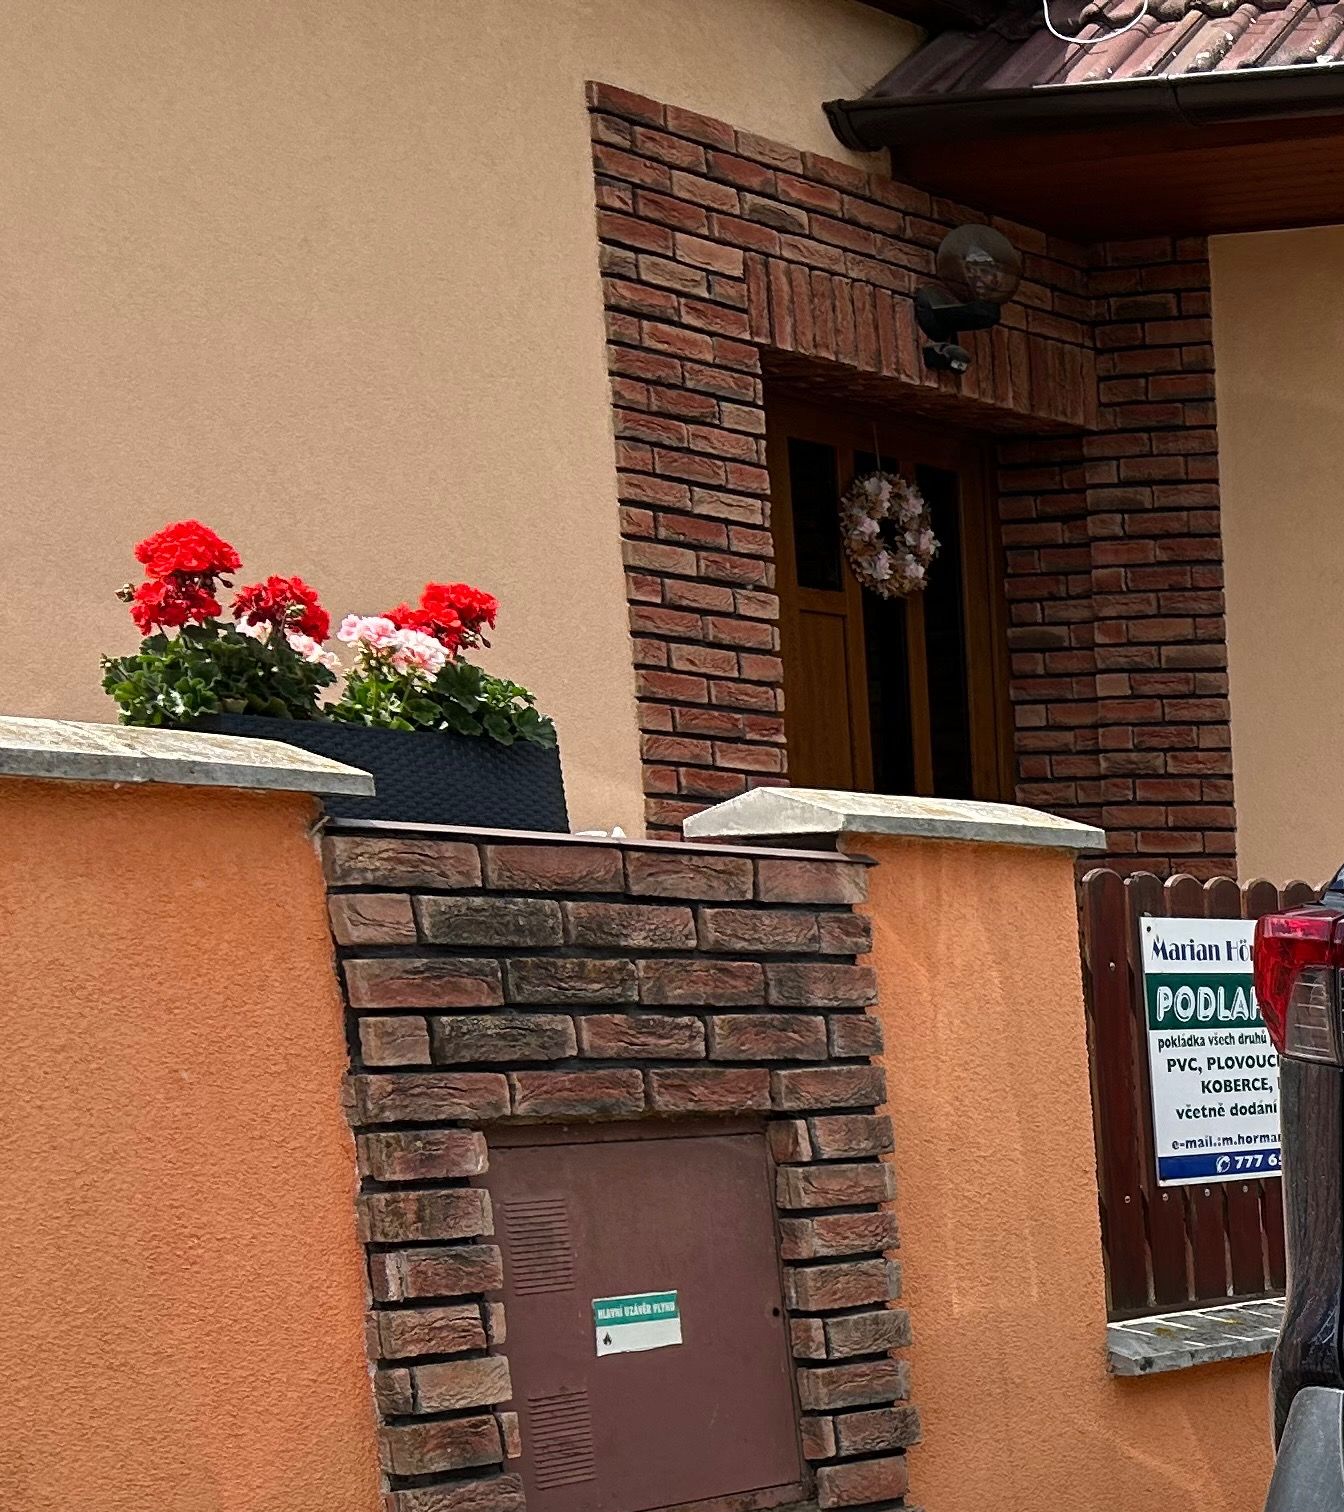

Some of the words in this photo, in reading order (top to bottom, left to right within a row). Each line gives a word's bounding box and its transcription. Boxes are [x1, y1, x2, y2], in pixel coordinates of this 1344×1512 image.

[1151, 938, 1220, 961] Marian
[1158, 1033, 1206, 1052] pokládka
[1208, 1032, 1235, 1046] všech
[1238, 1029, 1267, 1045] druhů
[1167, 1057, 1202, 1075] PVC,
[1201, 1077, 1273, 1094] KOBERCE,
[1175, 1102, 1226, 1120] včetně
[1230, 1099, 1278, 1116] dodání
[1234, 1155, 1263, 1169] 777
